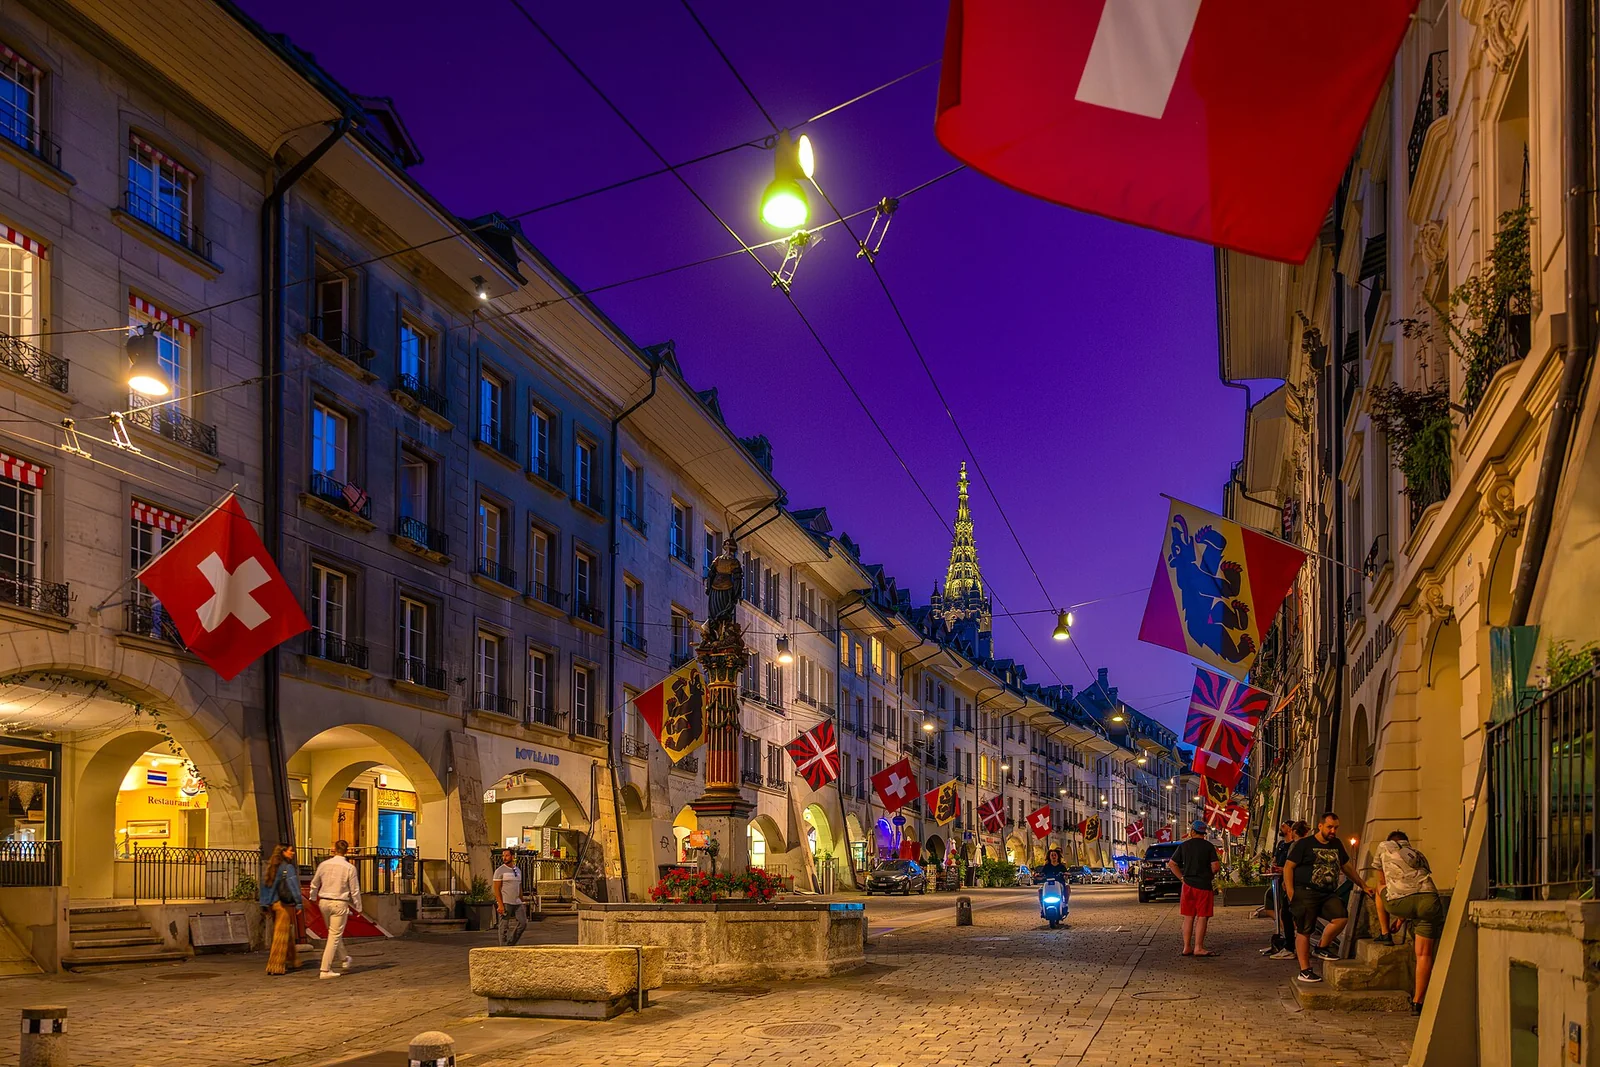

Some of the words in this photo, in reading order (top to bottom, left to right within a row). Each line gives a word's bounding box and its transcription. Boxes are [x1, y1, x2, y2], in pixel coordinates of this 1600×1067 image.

[515, 747, 560, 767] LOVELAND
[147, 796, 190, 808] Restaurant
[194, 801, 200, 809] &
